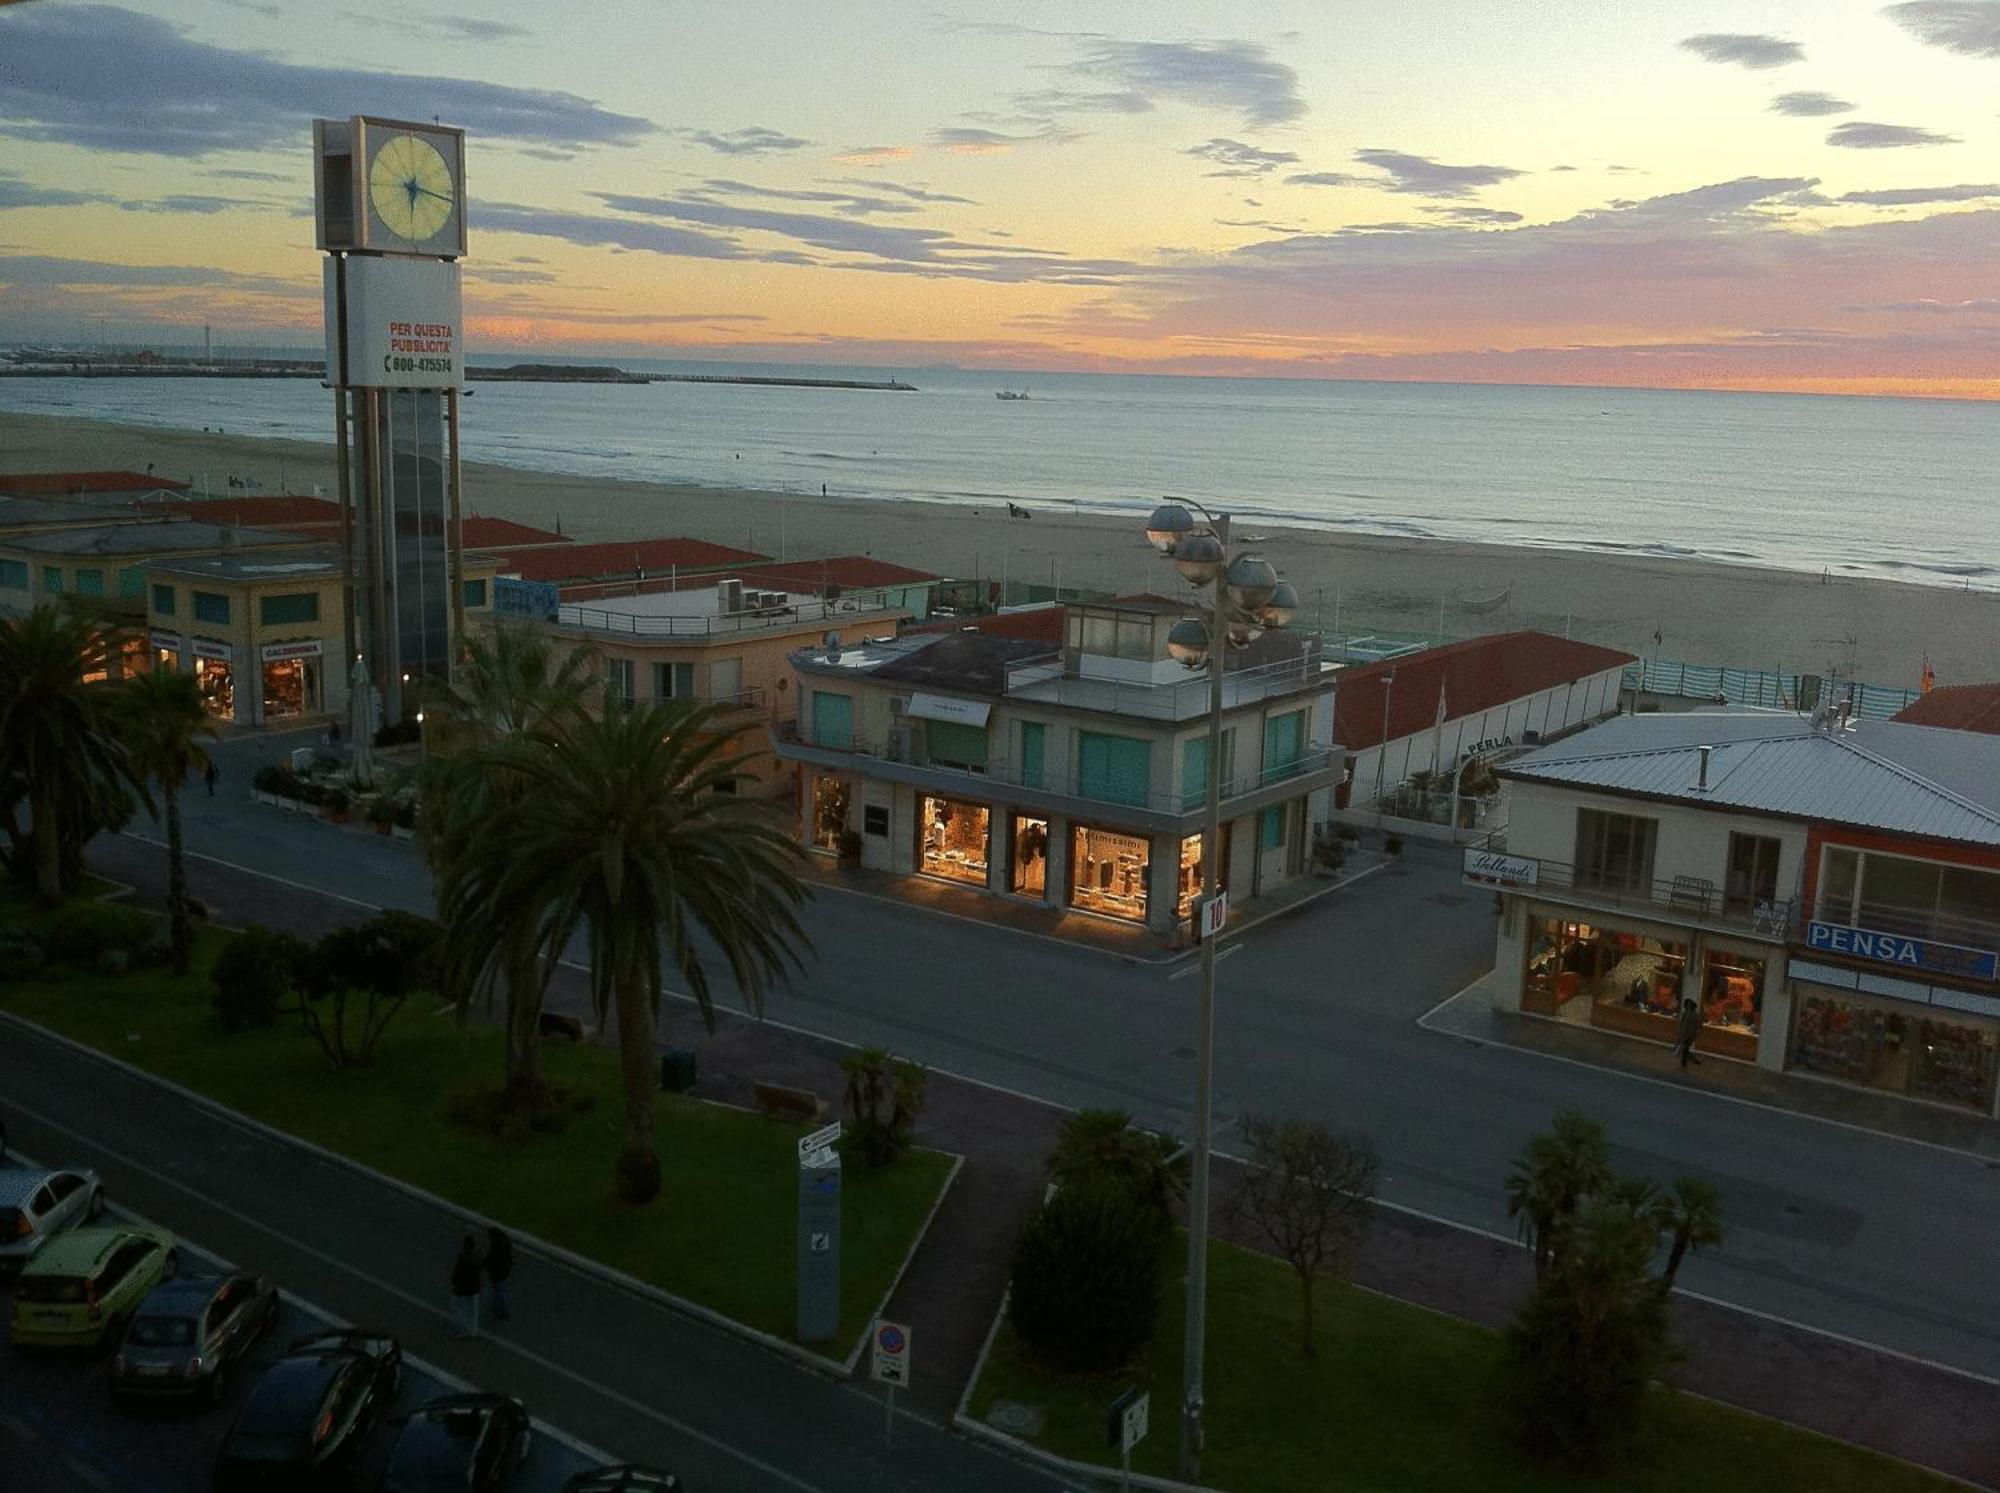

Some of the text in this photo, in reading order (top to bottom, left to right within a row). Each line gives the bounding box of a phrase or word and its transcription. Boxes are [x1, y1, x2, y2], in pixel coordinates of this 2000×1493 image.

[390, 322, 452, 337] PER QUESTA
[1468, 735, 1512, 755] PERLA
[1210, 899, 1223, 929] 10
[1811, 926, 1918, 964] PENSA
